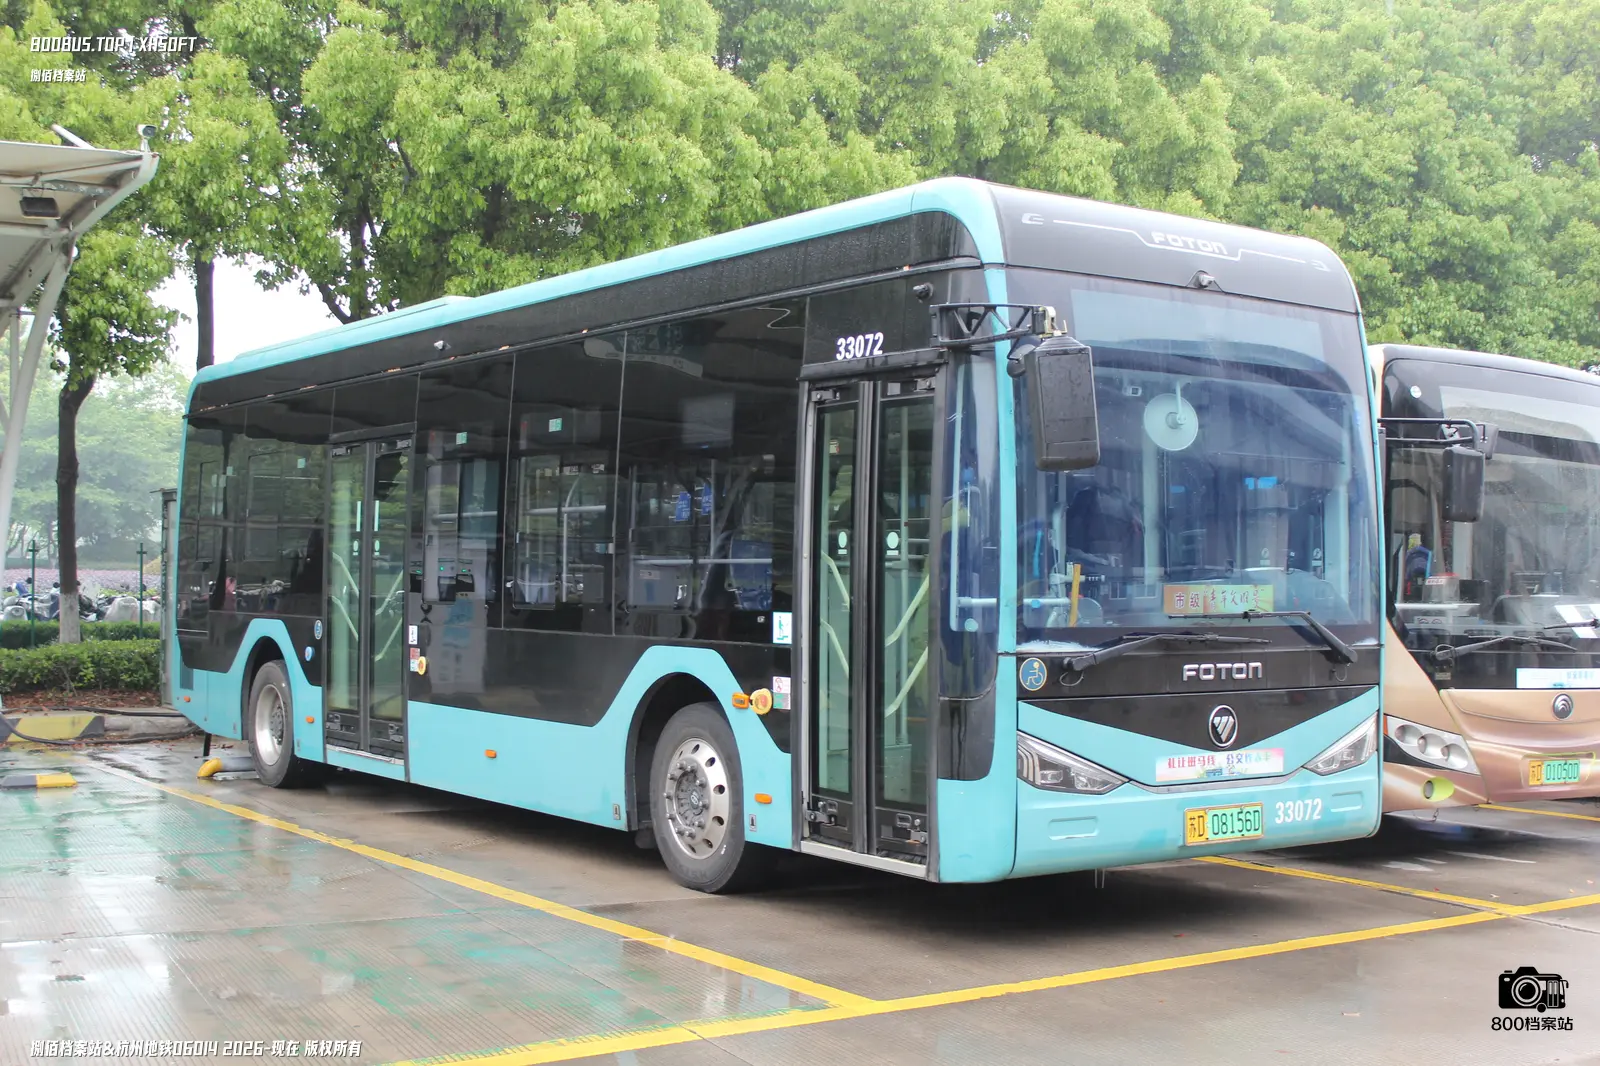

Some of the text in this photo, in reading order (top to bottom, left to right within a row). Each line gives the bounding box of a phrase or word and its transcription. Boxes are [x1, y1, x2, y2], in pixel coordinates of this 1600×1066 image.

[1151, 231, 1229, 256] FOTON
[836, 331, 884, 361] 33072
[1182, 661, 1263, 681] FOTON
[1211, 809, 1261, 836] 08156D
[1274, 797, 1322, 825] 33072
